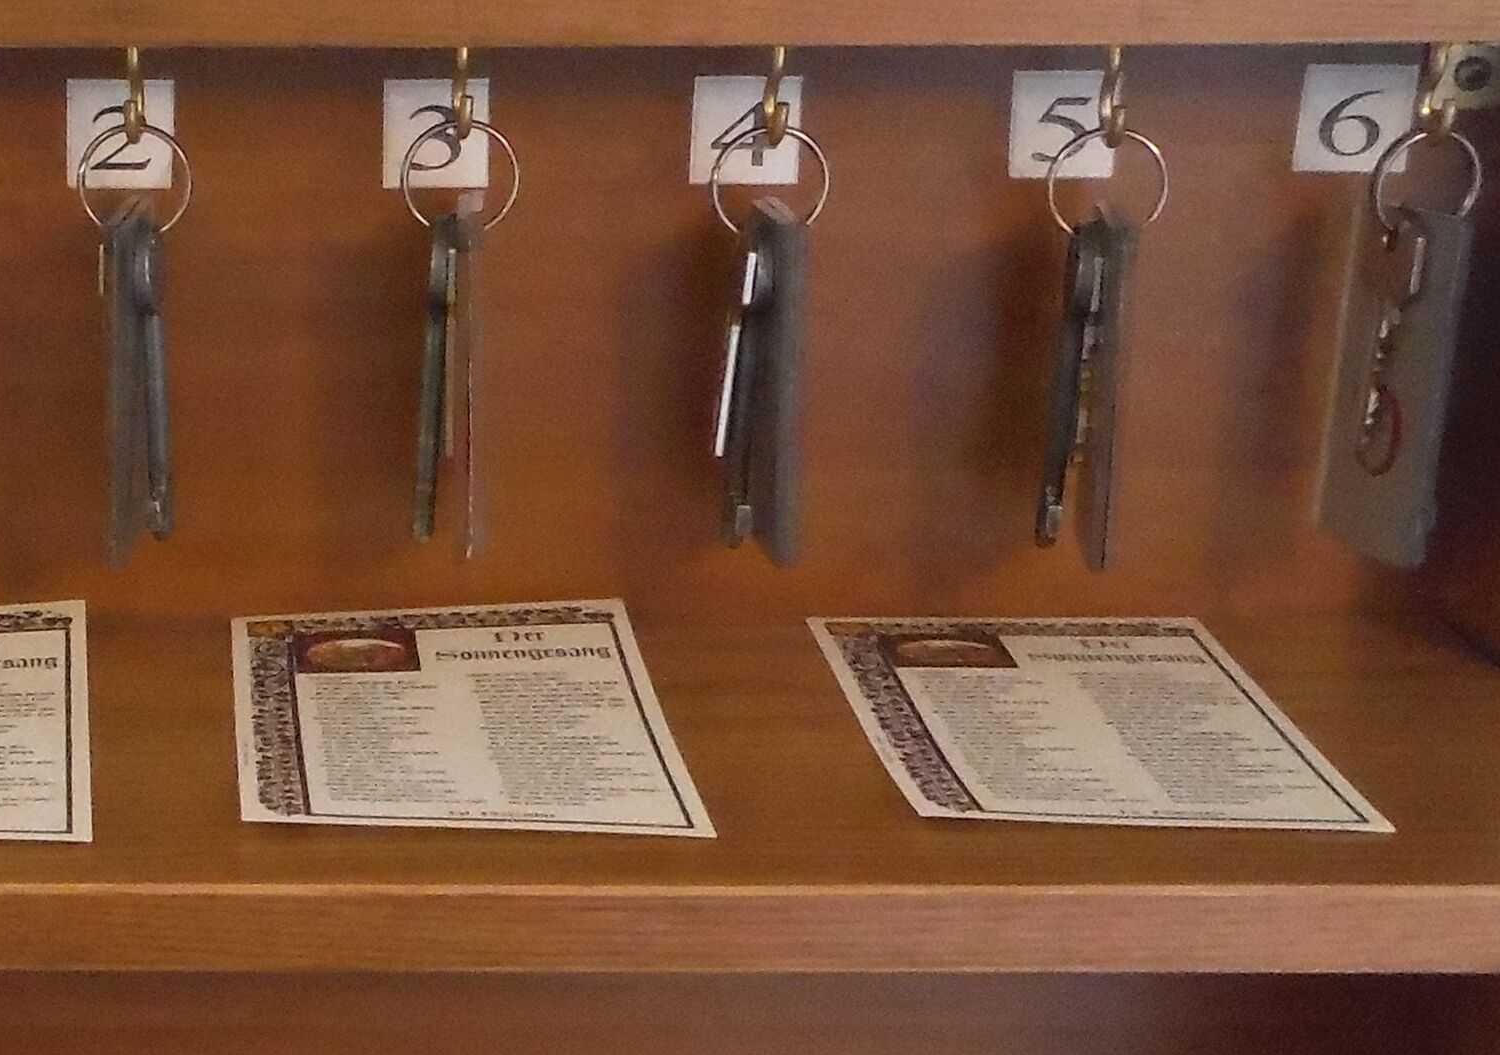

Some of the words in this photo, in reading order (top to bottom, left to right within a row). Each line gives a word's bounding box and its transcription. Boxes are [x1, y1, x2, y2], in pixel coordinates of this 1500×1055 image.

[91, 105, 152, 170] 2
[410, 105, 462, 170] 3
[711, 102, 778, 166] 4
[1031, 97, 1092, 162] 5
[1318, 89, 1385, 156] 6
[434, 643, 613, 663] Sonnengesang
